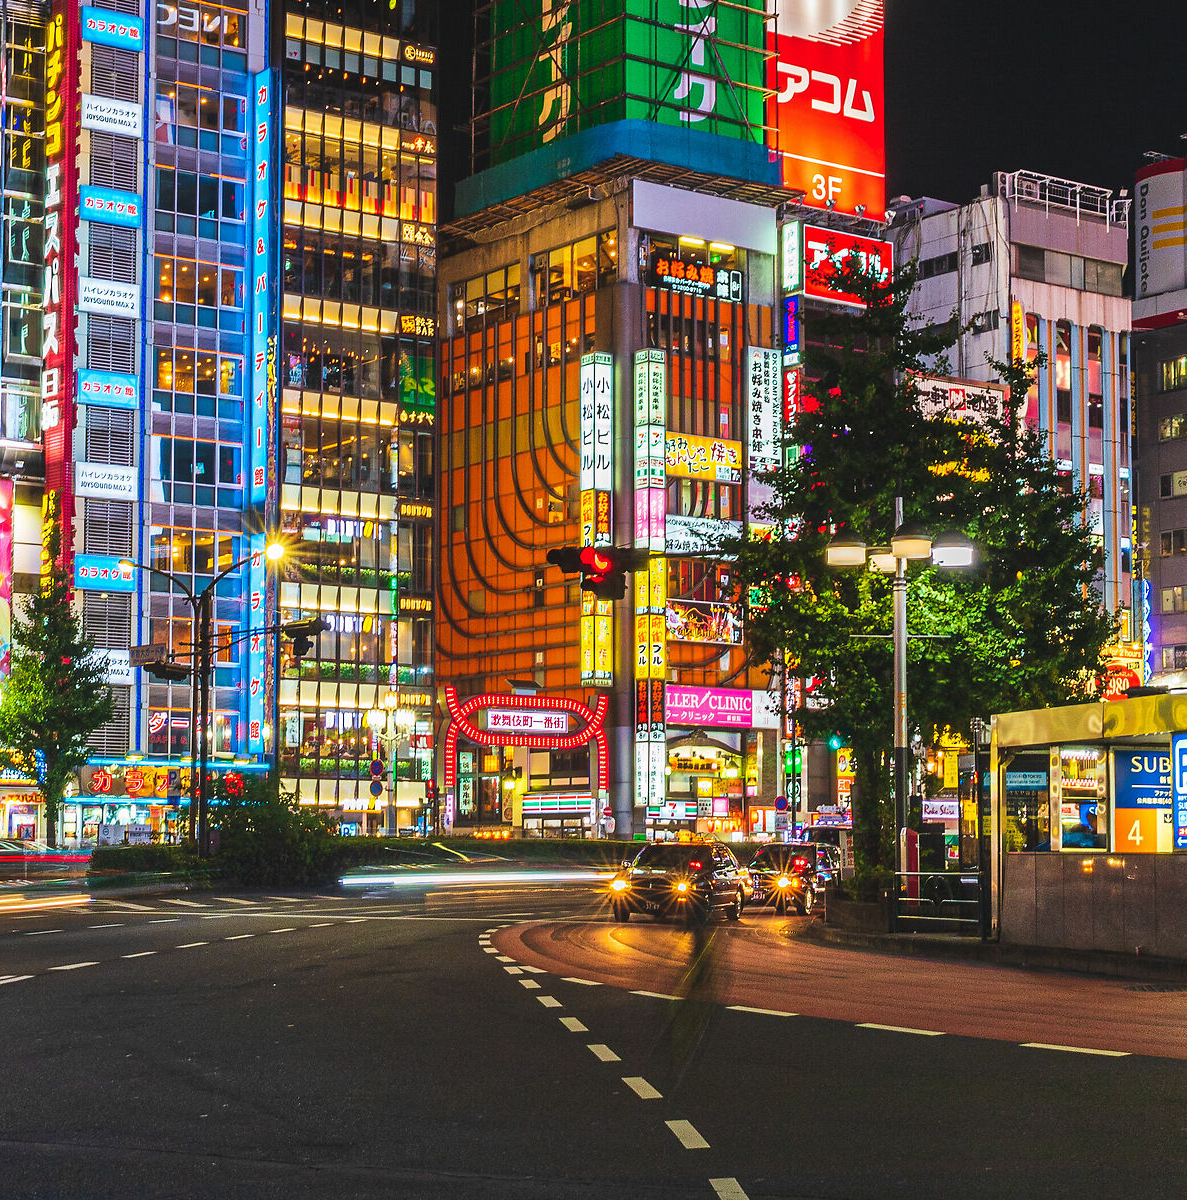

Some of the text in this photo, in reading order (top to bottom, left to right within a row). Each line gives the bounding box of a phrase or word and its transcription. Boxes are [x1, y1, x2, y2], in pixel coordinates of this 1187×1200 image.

[46, 15, 64, 156] パチンコ
[776, 61, 876, 123] アコム
[813, 173, 843, 200] 3F
[1140, 183, 1149, 220] Don
[42, 162, 60, 356] エスパス
[583, 377, 592, 470] 小松ビル
[597, 377, 610, 469] 小松ビル
[490, 714, 564, 729] 歌舞伎町一番街
[709, 695, 752, 711] CLINIC
[1128, 820, 1143, 845] 4
